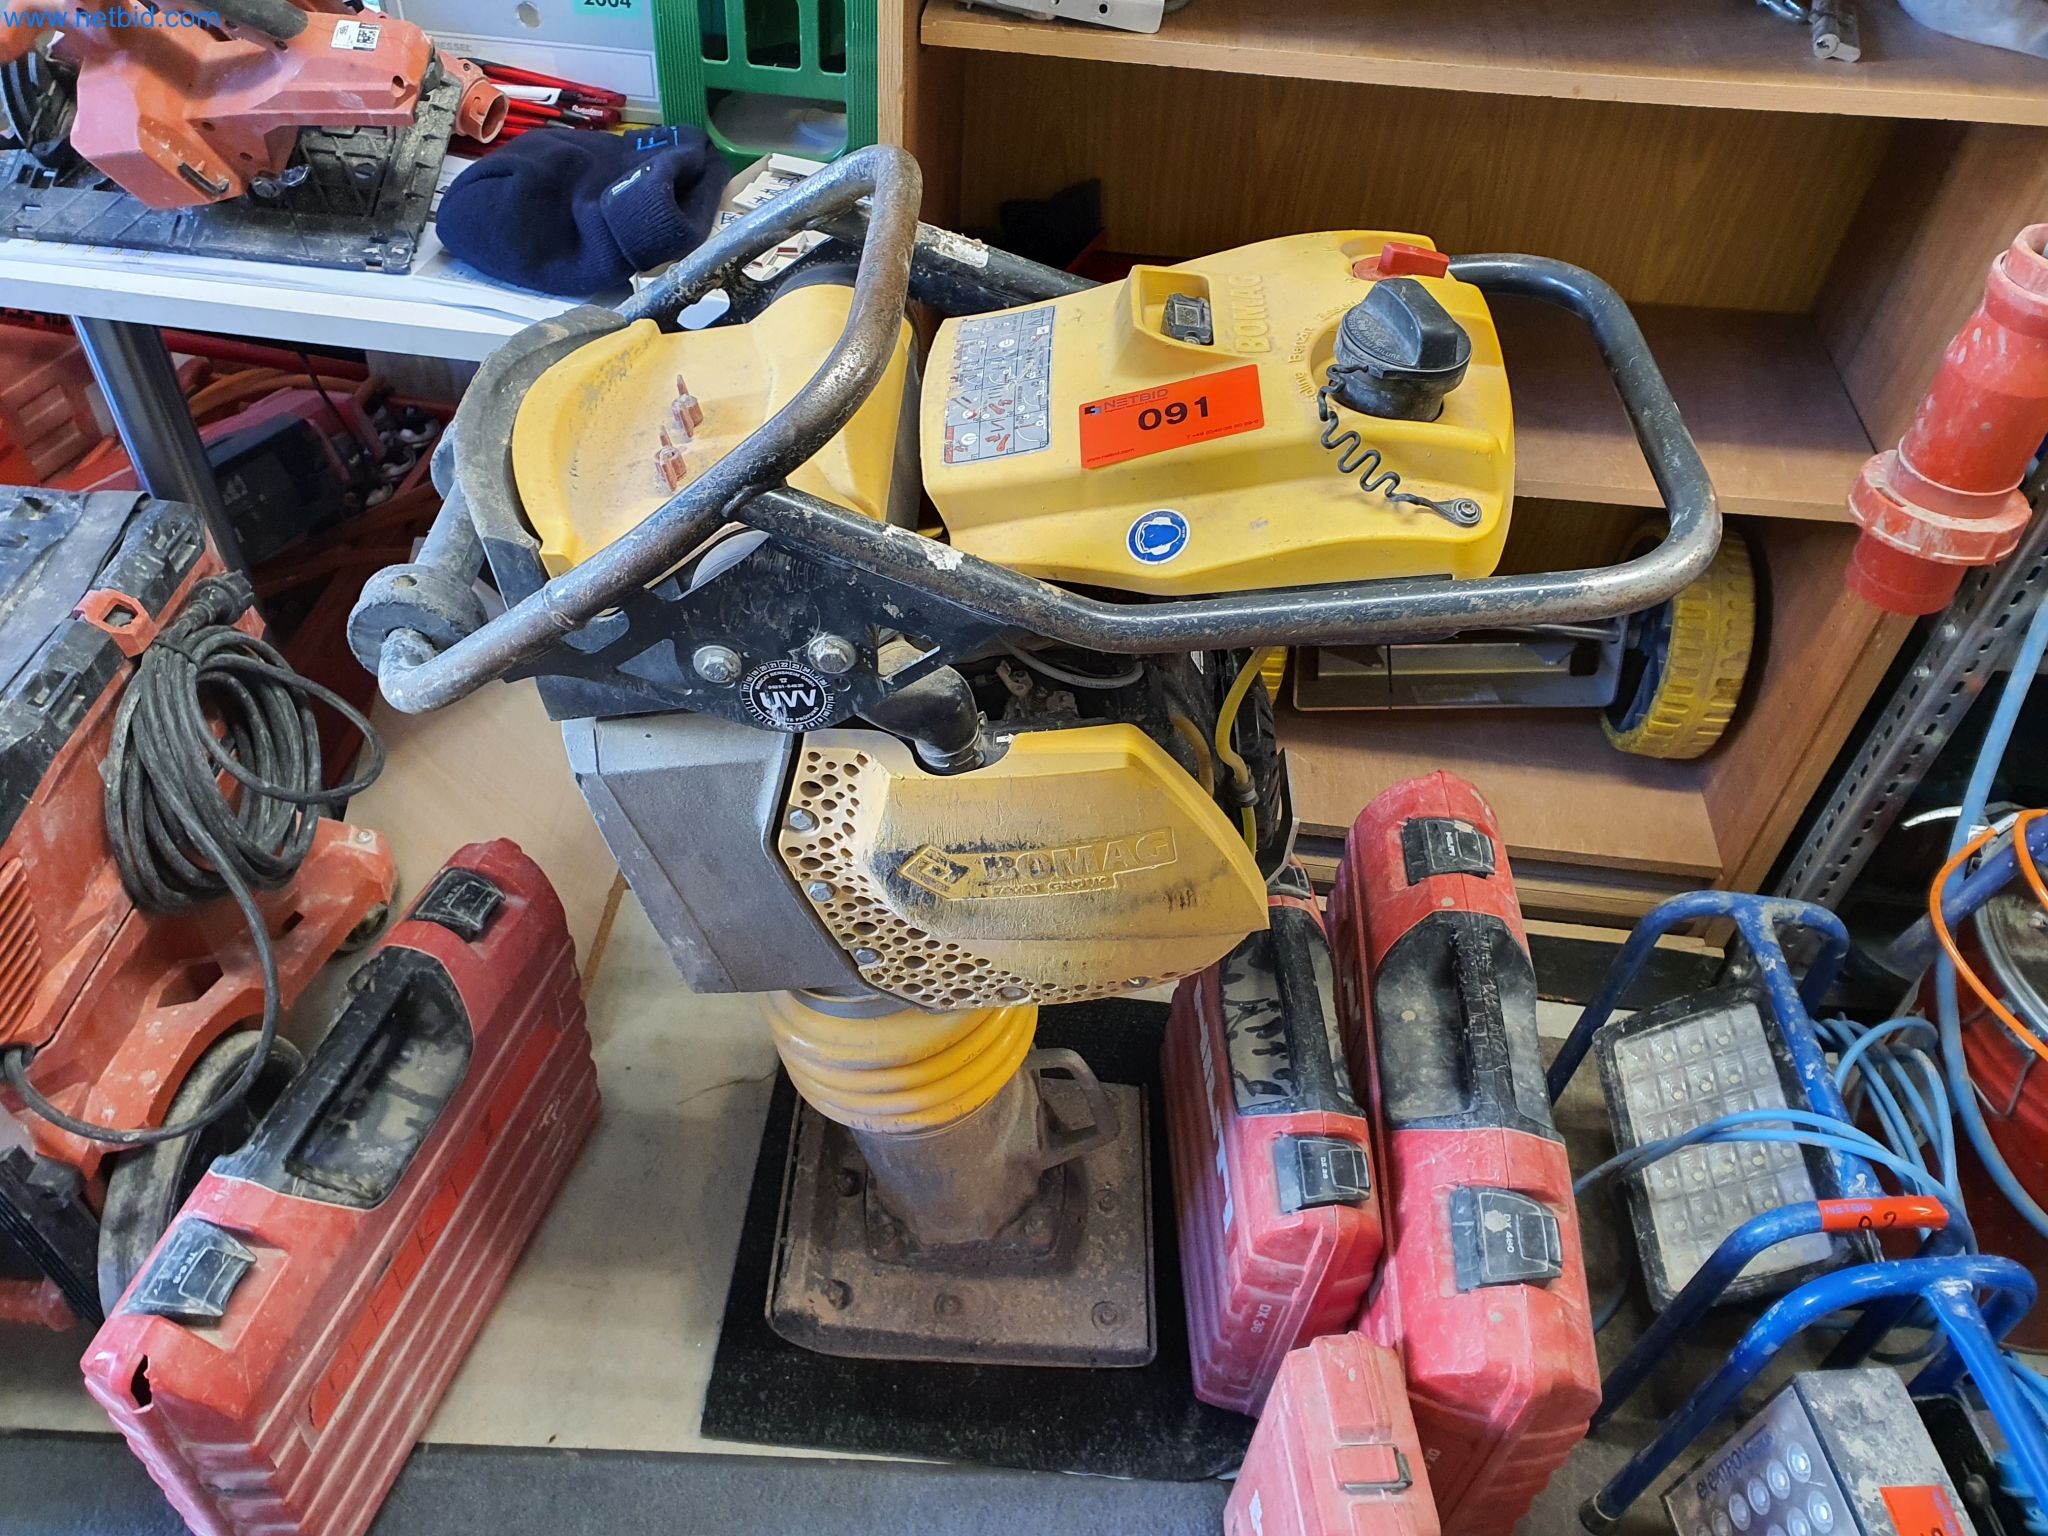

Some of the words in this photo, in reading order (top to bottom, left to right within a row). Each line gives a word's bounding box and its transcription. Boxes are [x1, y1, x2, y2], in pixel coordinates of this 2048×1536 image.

[1228, 274, 1272, 353] BOMAG
[1104, 389, 1168, 410] NETBID
[1138, 396, 1209, 431] 091
[759, 689, 817, 710] UVV
[983, 831, 1171, 881] BOMAG
[1256, 1303, 1273, 1319] DX
[1250, 1319, 1265, 1334] 36
